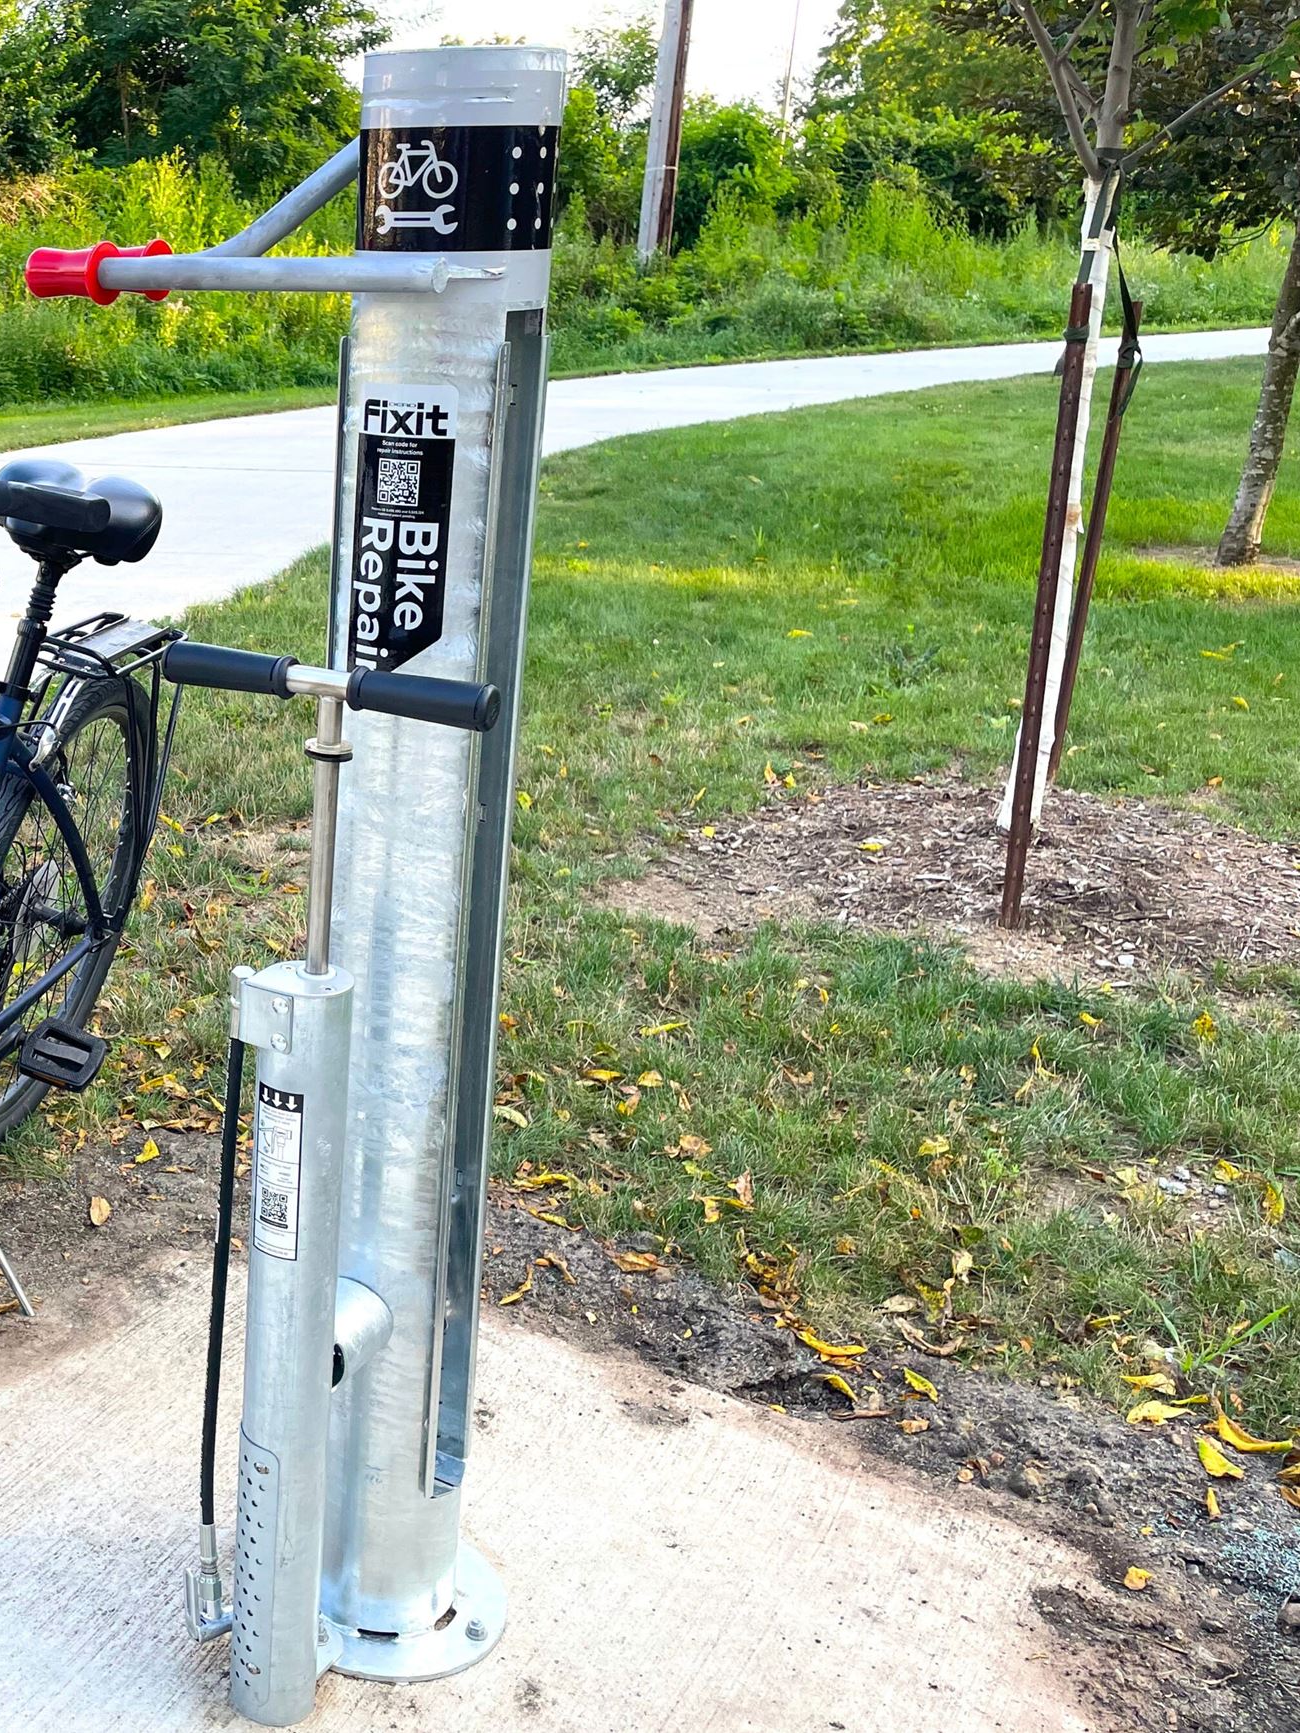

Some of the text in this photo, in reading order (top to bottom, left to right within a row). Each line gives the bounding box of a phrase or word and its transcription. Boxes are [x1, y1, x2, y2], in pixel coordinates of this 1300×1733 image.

[392, 448, 423, 456] instructions
[353, 517, 394, 671] Repair
[394, 521, 439, 630] Bike
